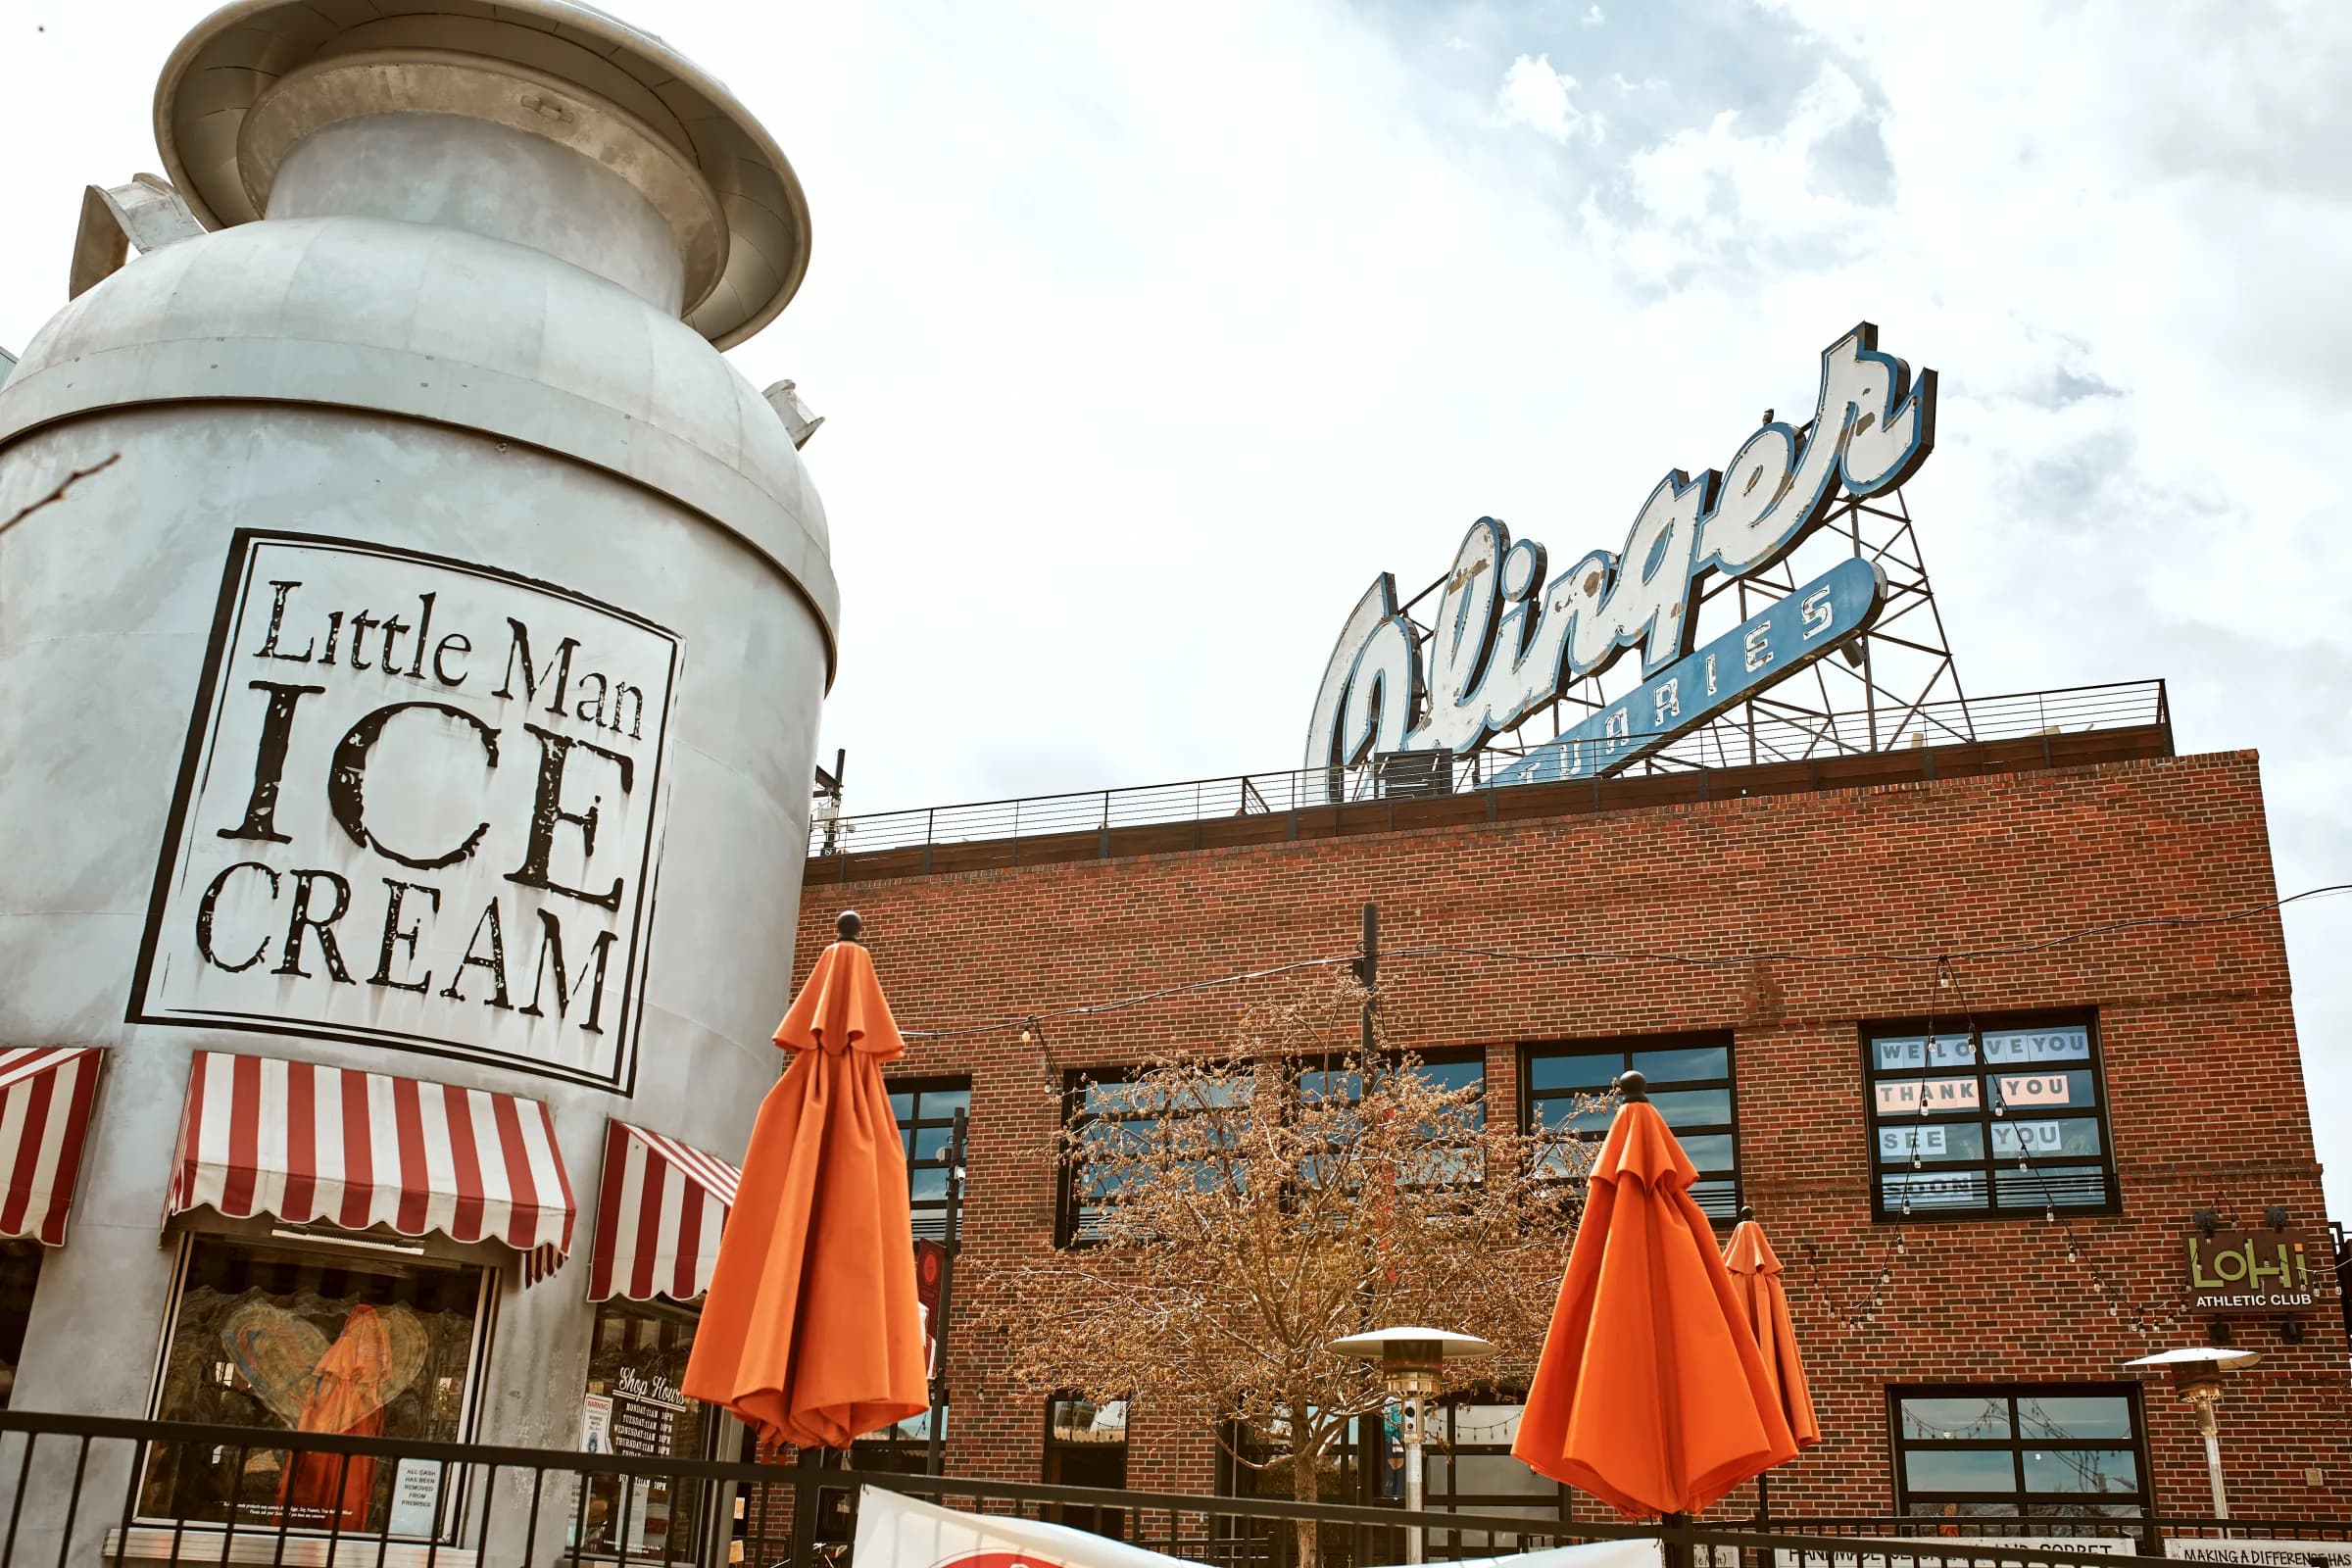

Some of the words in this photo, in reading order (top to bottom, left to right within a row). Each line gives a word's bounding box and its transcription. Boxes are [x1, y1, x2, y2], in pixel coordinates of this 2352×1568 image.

[253, 579, 472, 686] Little
[491, 616, 645, 741] Man
[217, 680, 635, 913] ICE
[195, 860, 619, 1035] CREAM
[1882, 1044, 1921, 1059] WE
[1936, 1037, 2023, 1058] LOVE
[2033, 1035, 2084, 1054] YOU
[1880, 1082, 1976, 1103] THANK
[2006, 1078, 2064, 1097] YOU
[1883, 1130, 1943, 1151] SEE
[1993, 1126, 2058, 1146] YOU
[2196, 1295, 2267, 1307] ATHLETIC
[2270, 1294, 2313, 1306] CLUB
[618, 1367, 648, 1401] Shop
[651, 1375, 684, 1405] Hours
[2183, 1549, 2238, 1564] MAKING
[2240, 1550, 2250, 1564] A
[2328, 1552, 2351, 1567] HAS
